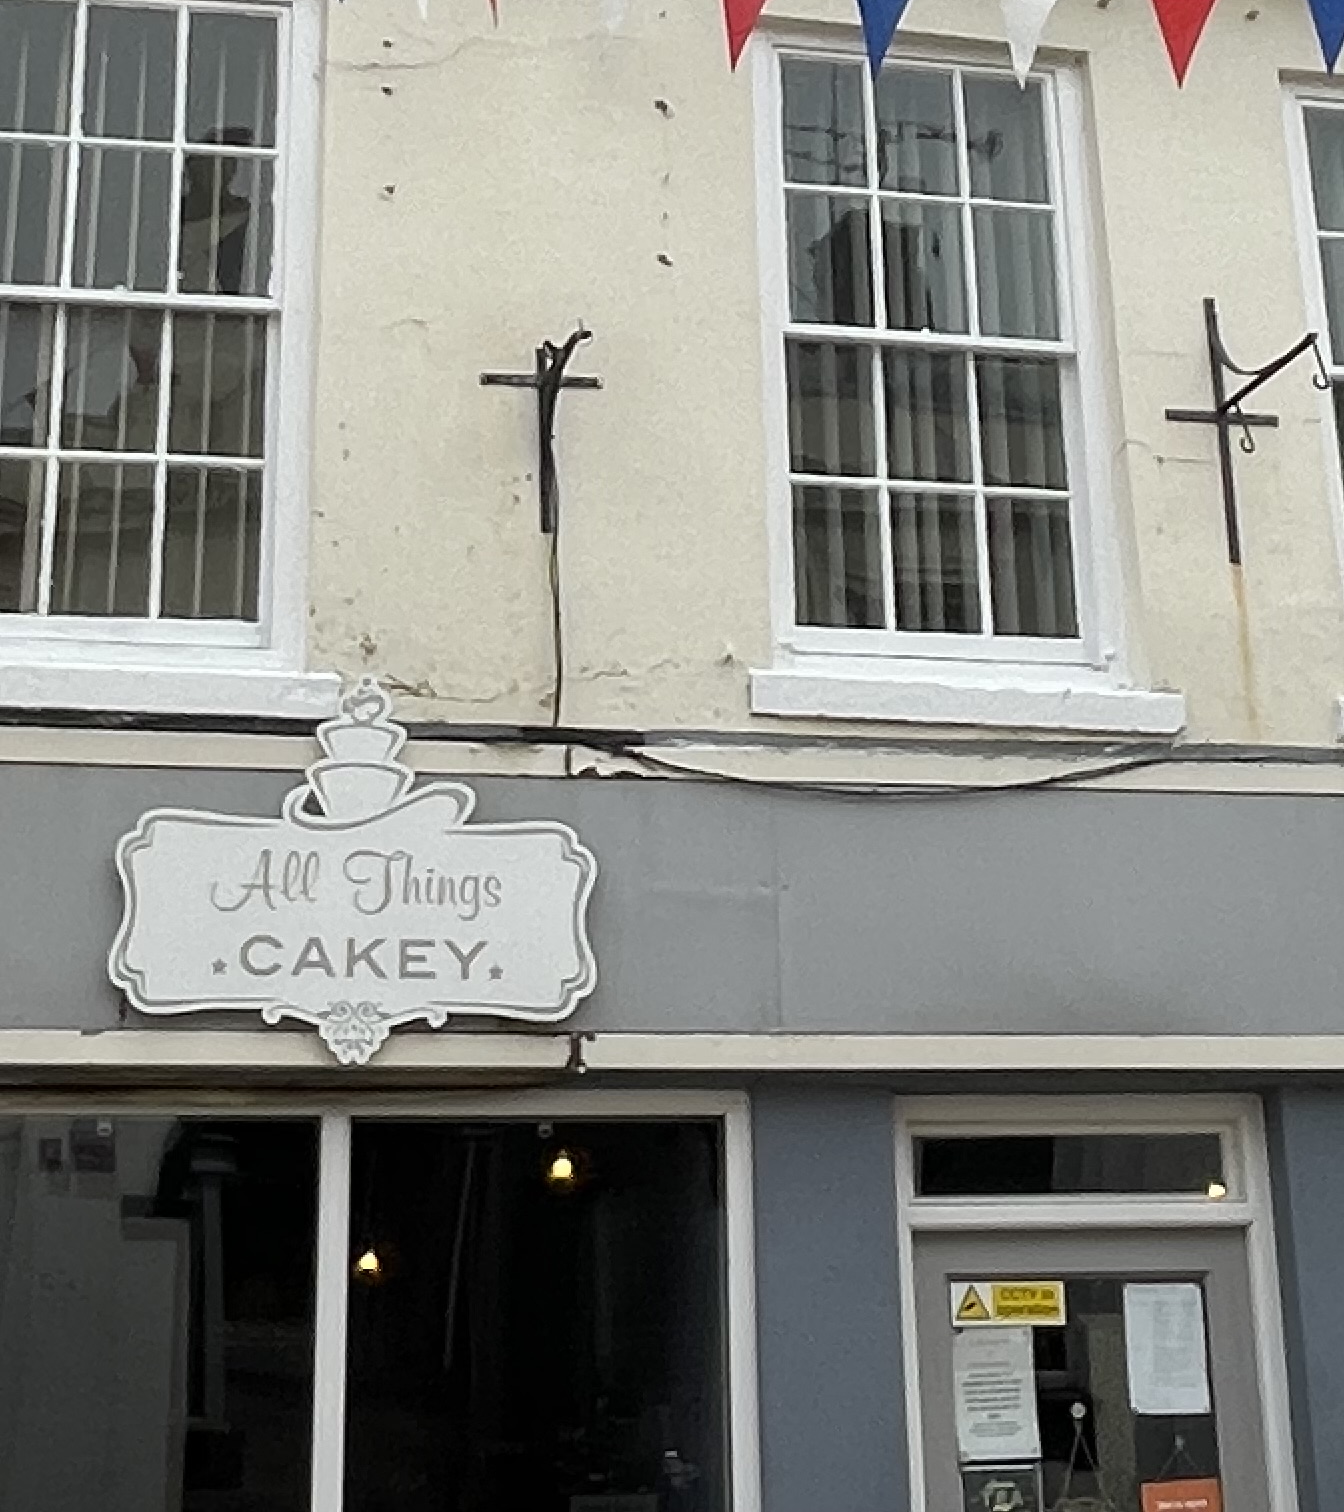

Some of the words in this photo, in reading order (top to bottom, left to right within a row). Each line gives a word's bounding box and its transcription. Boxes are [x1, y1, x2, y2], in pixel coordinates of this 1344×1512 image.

[210, 848, 321, 912] All
[343, 850, 502, 920] Things
[239, 934, 488, 980] CAKEY
